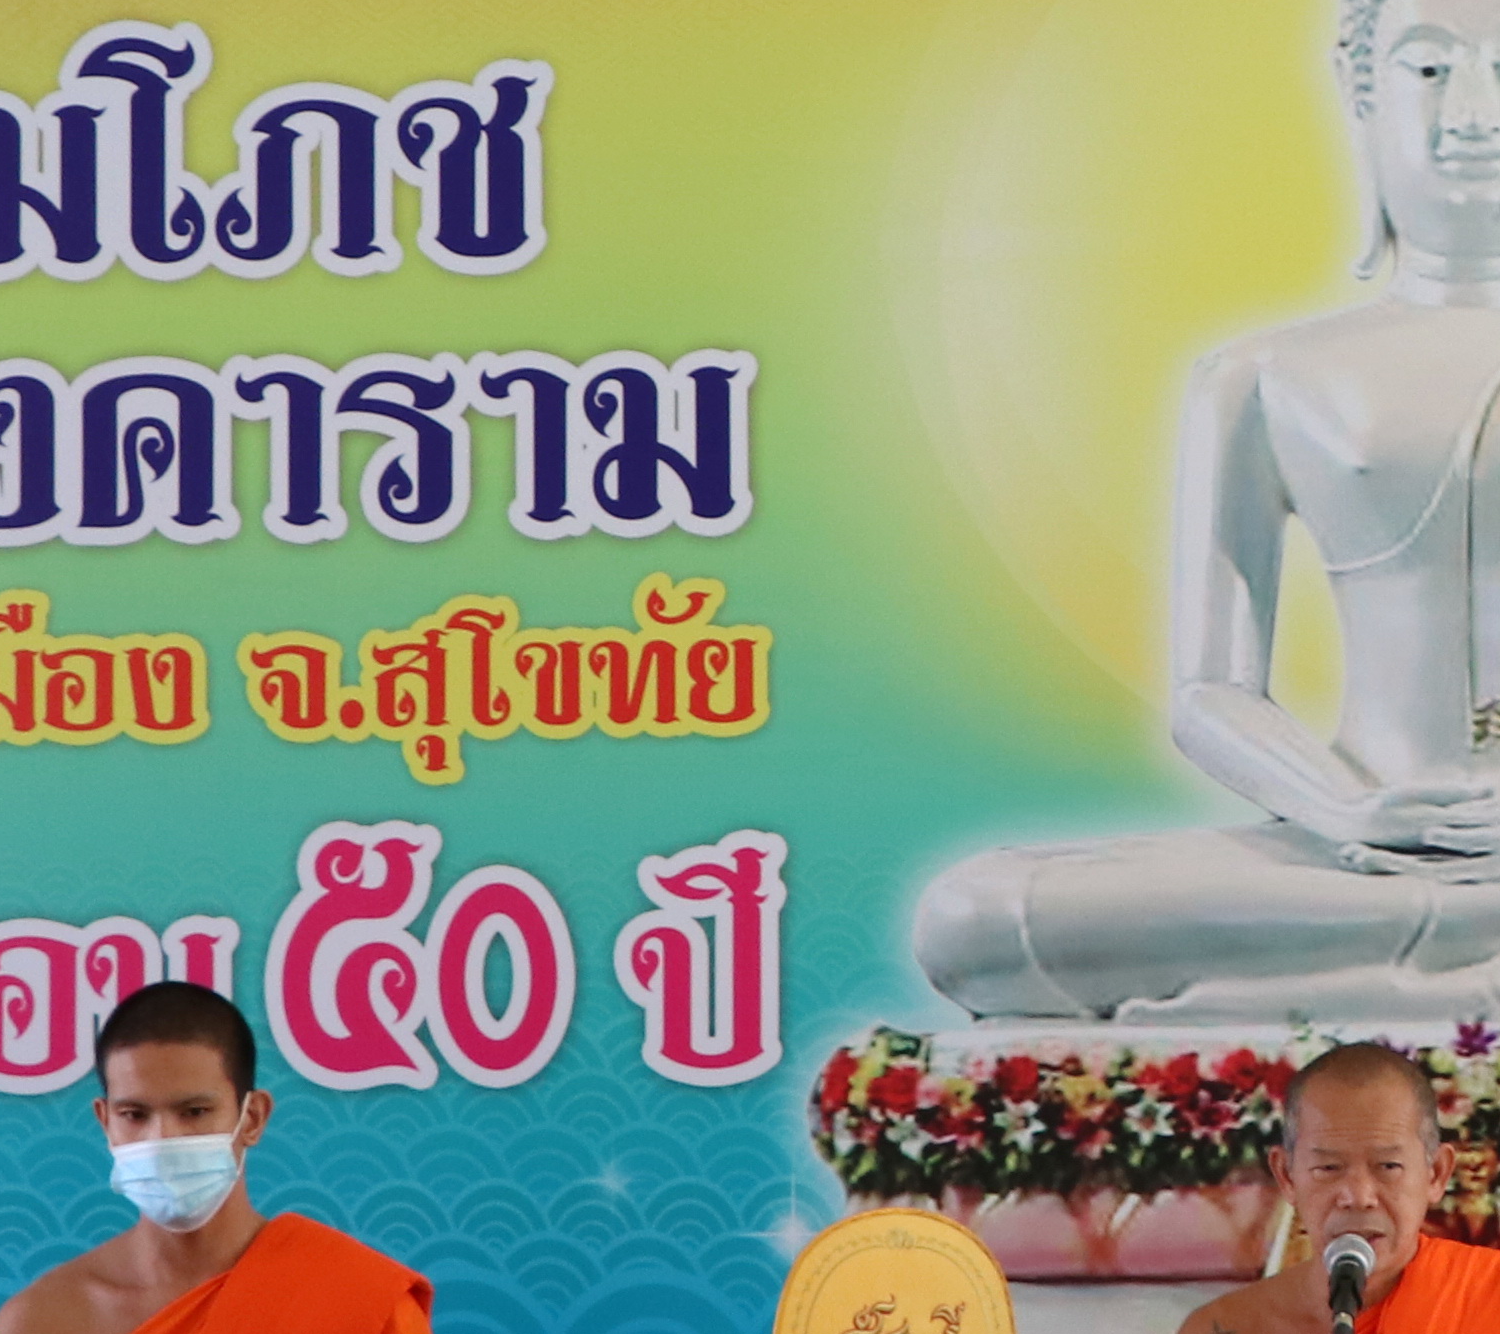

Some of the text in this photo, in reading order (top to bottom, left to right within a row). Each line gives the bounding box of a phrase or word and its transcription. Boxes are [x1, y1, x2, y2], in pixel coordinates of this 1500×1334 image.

[249, 589, 758, 773] จ.สุโขทัย
[281, 837, 560, 1074] ๕๐
[630, 845, 770, 1071] ปี
